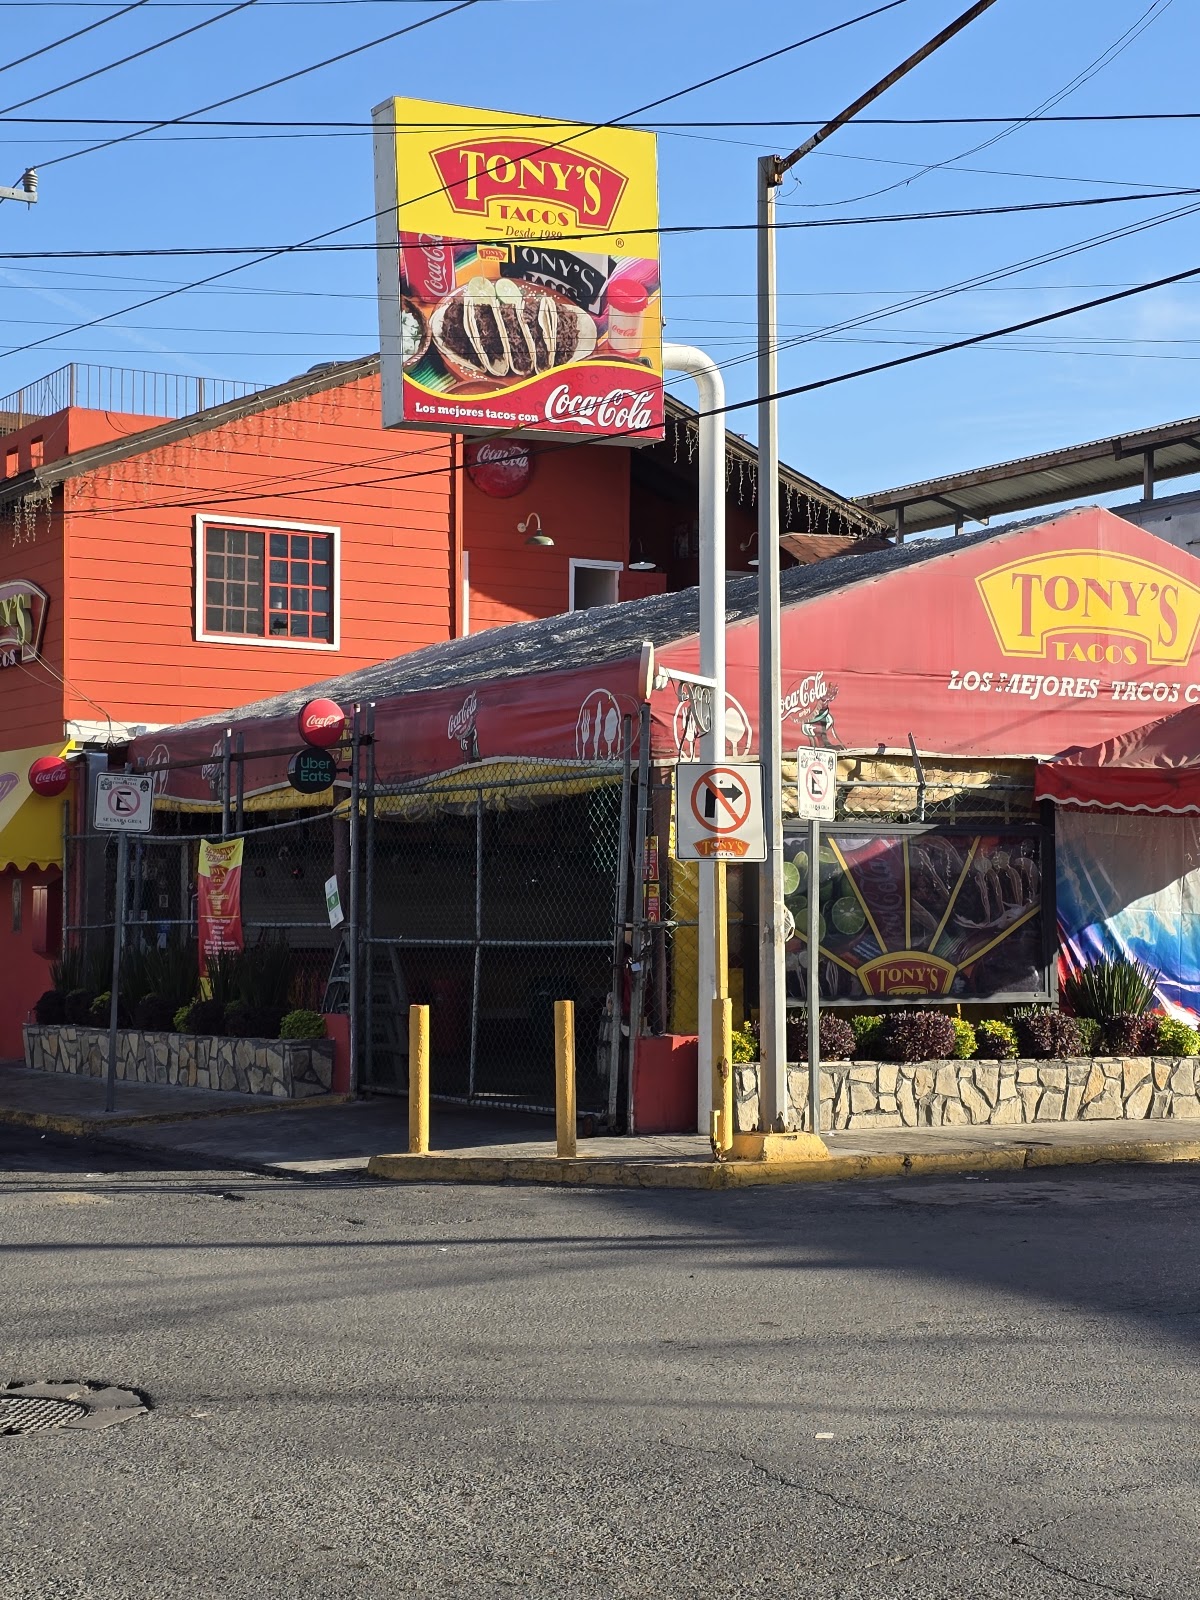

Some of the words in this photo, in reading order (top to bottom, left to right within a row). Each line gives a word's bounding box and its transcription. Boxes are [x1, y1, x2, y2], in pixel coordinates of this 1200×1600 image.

[459, 149, 602, 216] TONY'S
[497, 204, 569, 226] TACOS
[505, 225, 536, 238] Desde
[415, 402, 436, 414] Los
[437, 405, 484, 418] mejores
[485, 408, 516, 421] tacos
[517, 412, 539, 423] con
[1012, 572, 1180, 648] TONY'S
[1052, 641, 1138, 665] TACOS
[947, 670, 992, 692] LOS
[998, 672, 1100, 701] MEJORES
[1110, 680, 1179, 703] TACOS
[300, 757, 331, 769] Uber
[300, 770, 331, 782] Eats
[701, 840, 745, 855] TONY'S
[876, 966, 939, 992] TONY'S
